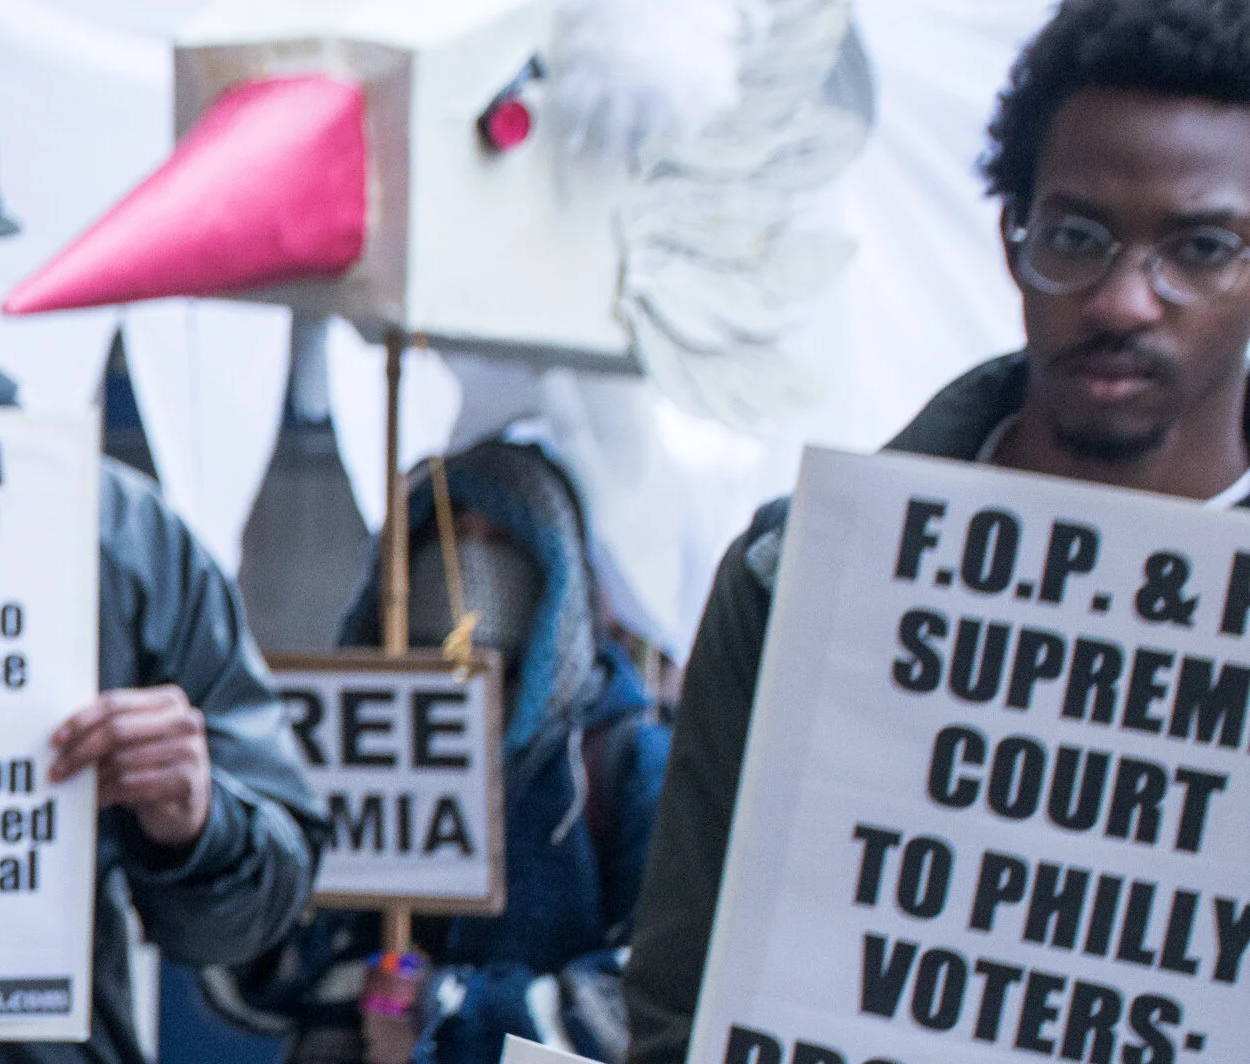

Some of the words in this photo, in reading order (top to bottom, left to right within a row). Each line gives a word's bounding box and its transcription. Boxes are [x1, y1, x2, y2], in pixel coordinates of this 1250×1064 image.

[893, 499, 1114, 612] F.O.P.
[1134, 551, 1199, 628] &
[282, 690, 470, 769] REE
[892, 609, 1250, 750] SUPREM
[327, 793, 474, 856] MIA
[927, 725, 1228, 854] COURT
[853, 824, 954, 920] TO
[969, 850, 1250, 984] PHILLY
